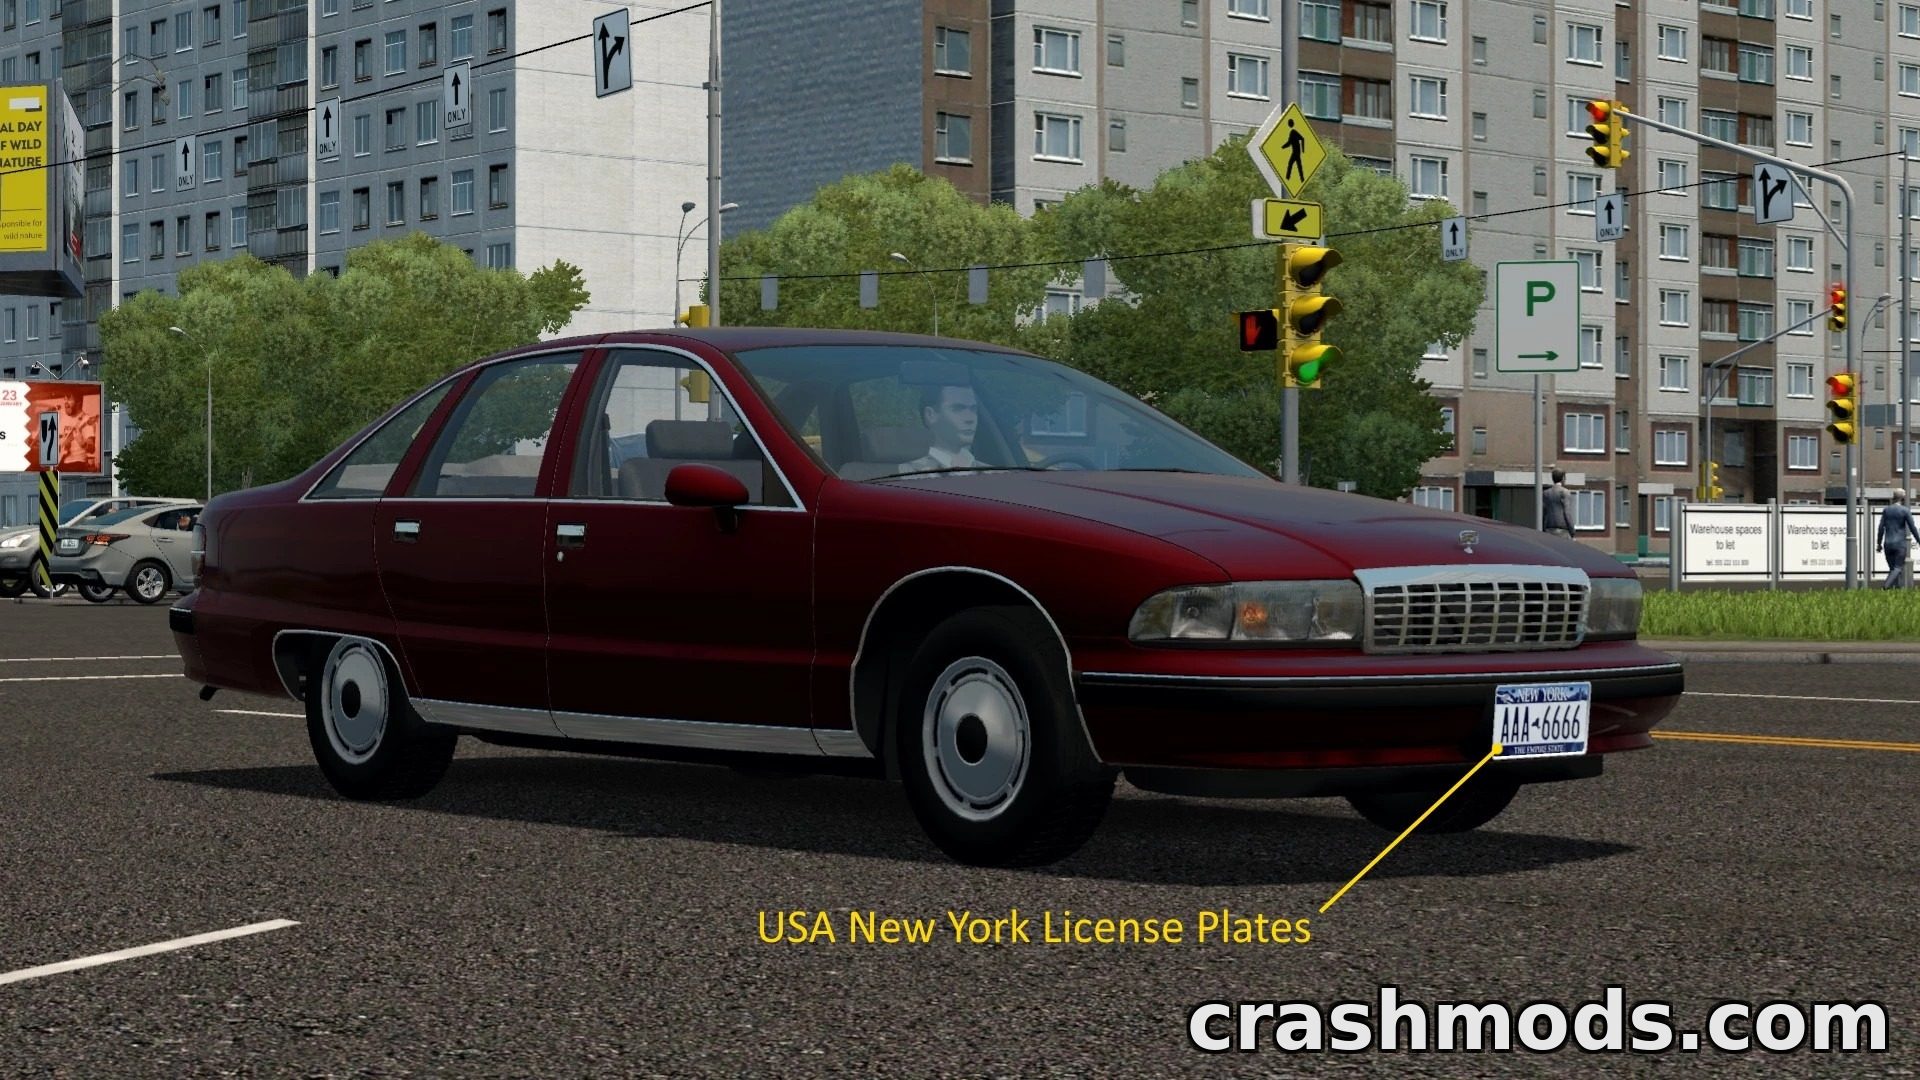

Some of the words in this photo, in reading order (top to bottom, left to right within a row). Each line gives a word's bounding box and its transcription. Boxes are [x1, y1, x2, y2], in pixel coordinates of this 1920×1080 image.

[447, 108, 466, 123] ONLY
[17, 120, 42, 133] DAY
[10, 138, 42, 151] WILD
[319, 140, 337, 154] ONLY
[178, 174, 194, 187] ONLY
[32, 219, 42, 227] for
[3, 232, 19, 240] wild
[1600, 226, 1620, 238] ONLY
[1445, 247, 1464, 258] ONLY
[1526, 280, 1556, 317] P
[2, 389, 17, 401] 23
[1690, 523, 1734, 534] Warehouse
[1735, 525, 1762, 536] spaces
[1787, 524, 1828, 535] Warehouse
[1829, 526, 1847, 537] spac
[1716, 540, 1724, 550] to
[1725, 540, 1735, 550] let
[1811, 540, 1819, 550] to
[1820, 540, 1830, 550] let
[1518, 687, 1540, 703] NEW
[1542, 686, 1568, 702] YORK
